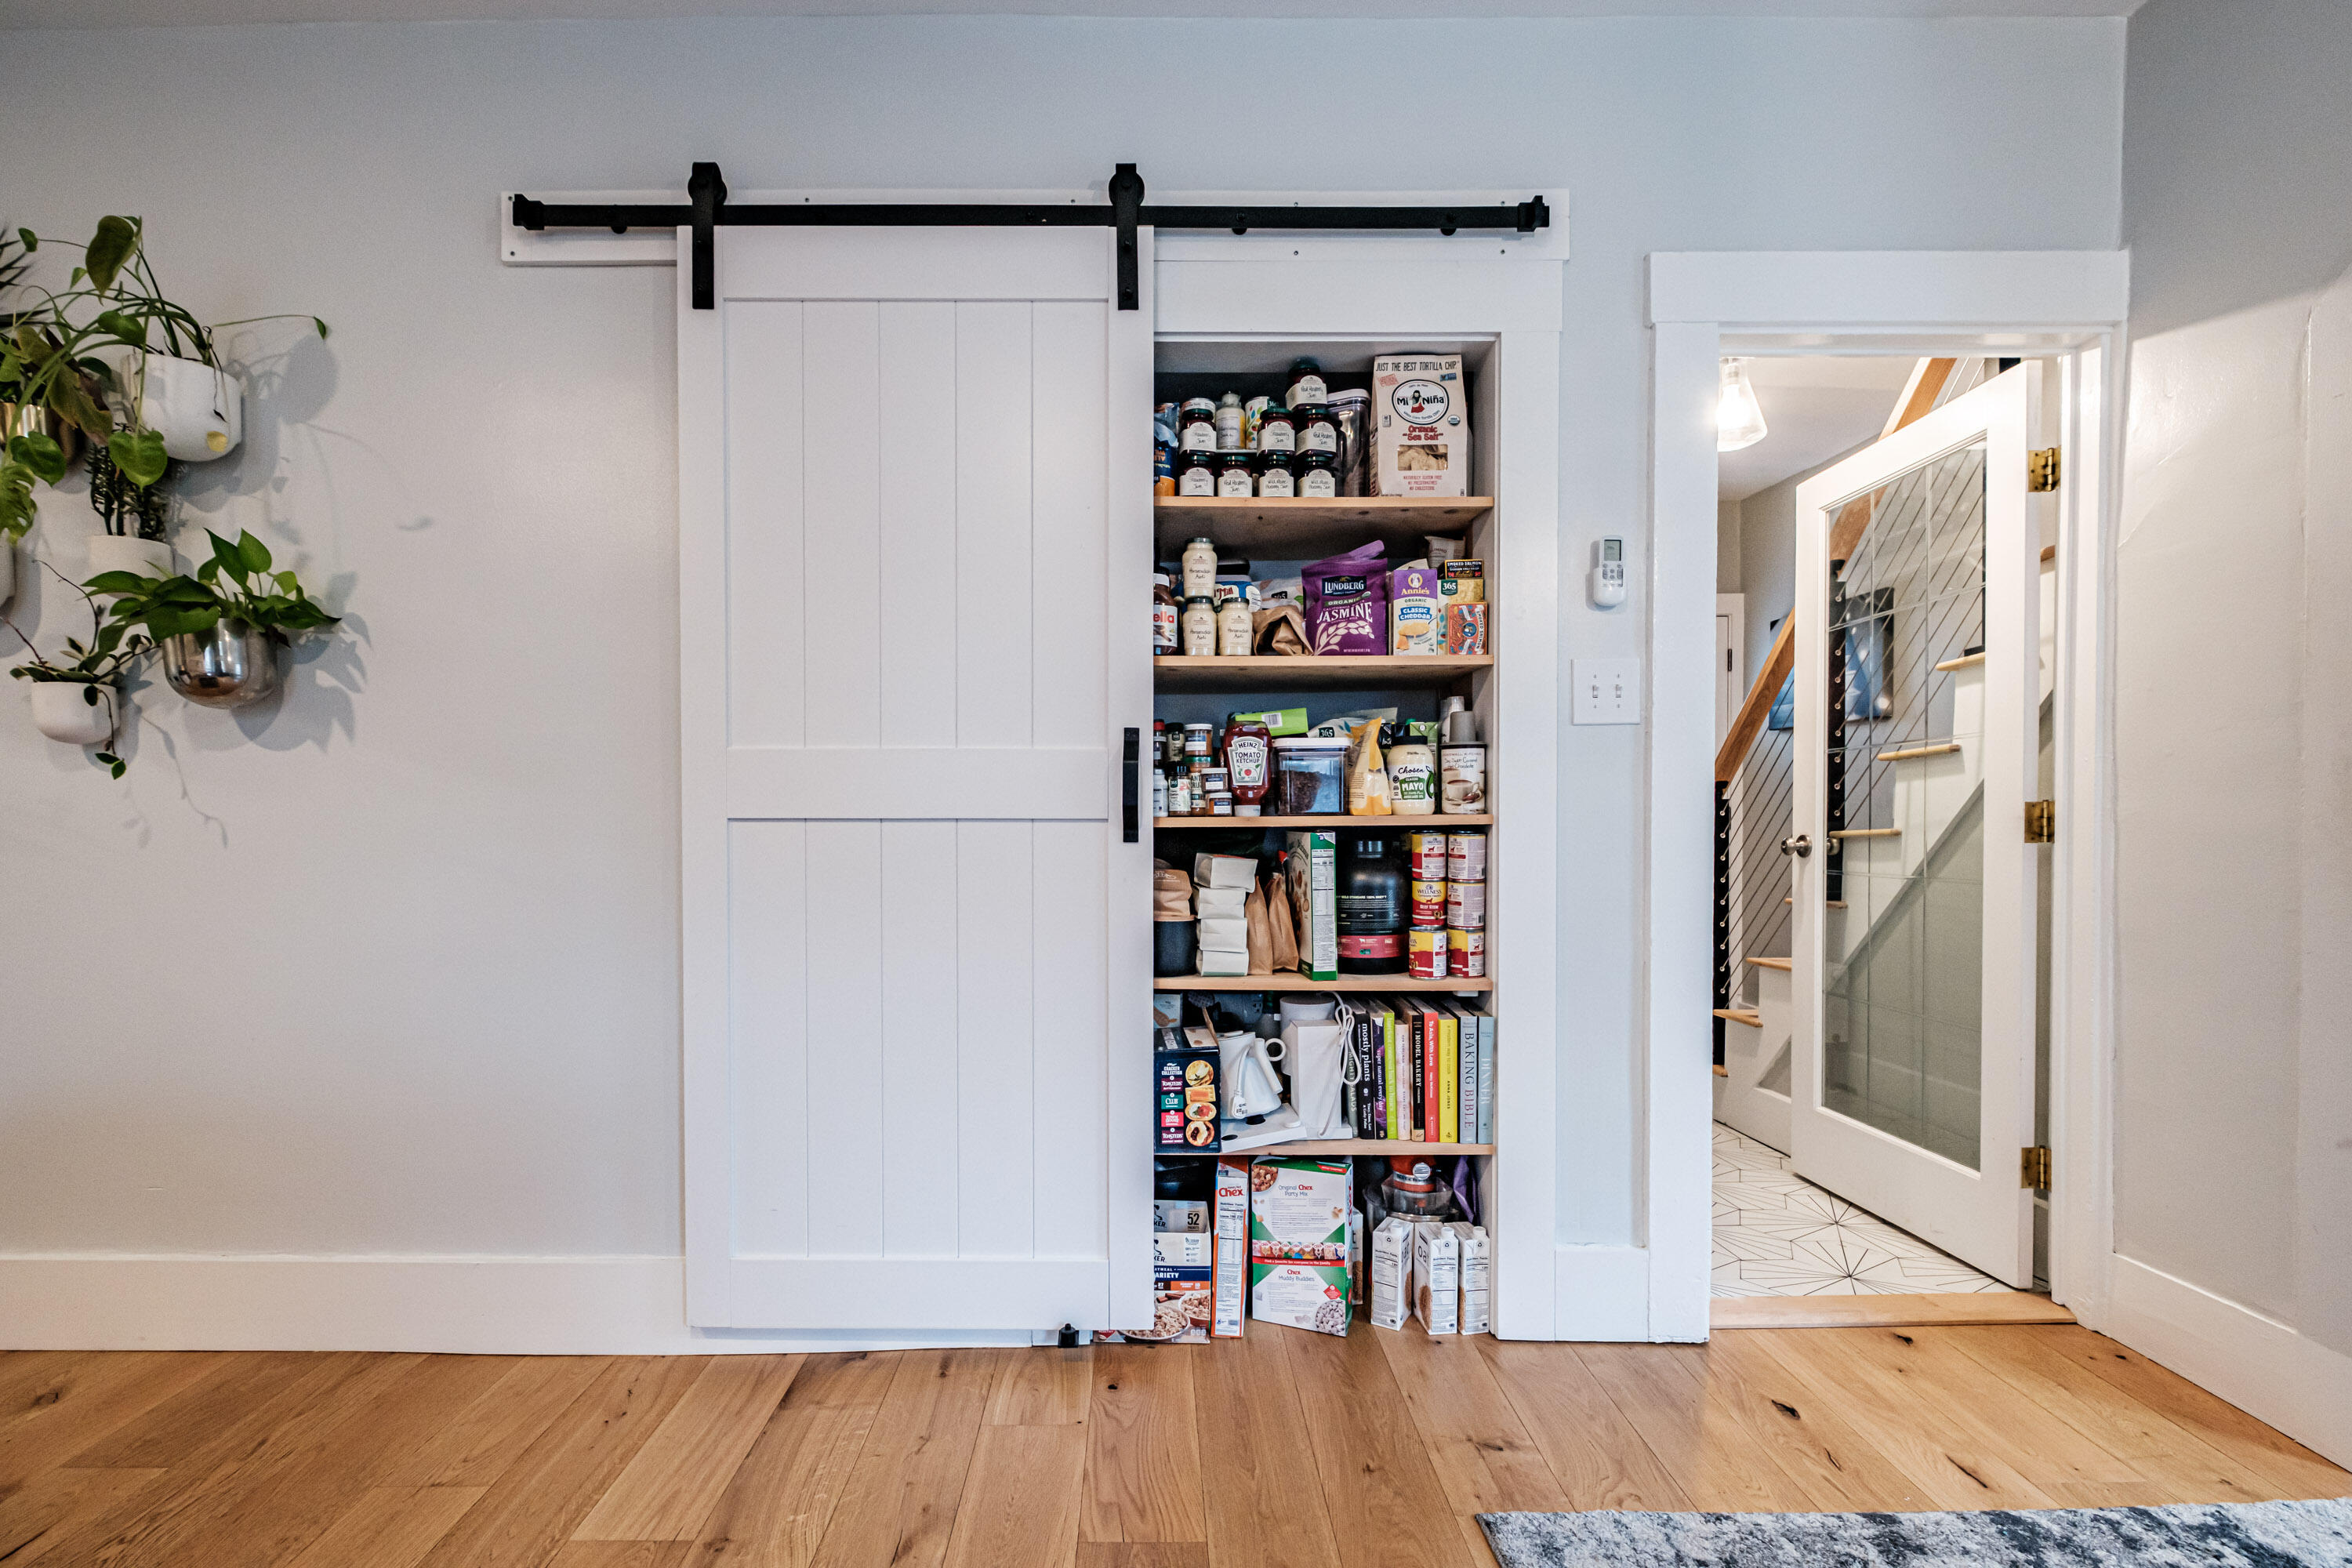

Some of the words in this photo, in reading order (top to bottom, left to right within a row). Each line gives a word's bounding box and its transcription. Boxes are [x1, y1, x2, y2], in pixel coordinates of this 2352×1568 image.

[1376, 362, 1389, 372] JUST
[1392, 362, 1401, 371] THE
[1403, 361, 1417, 371] BEST
[1420, 361, 1443, 371] TORTILLA
[1445, 361, 1457, 370] CHIP
[1422, 395, 1444, 405] Niña
[1324, 580, 1364, 593] LUNDBERG
[1401, 587, 1430, 596] Annie's
[1328, 597, 1360, 605] ORGANIC
[1316, 602, 1373, 624] JASMINE
[1402, 782, 1424, 791] MAYO
[1362, 1023, 1370, 1054] mostly
[1465, 1033, 1475, 1084] BAKING
[1362, 1054, 1371, 1082] plants
[1480, 1058, 1491, 1104] DINNER
[1465, 1090, 1475, 1129] BIBLE
[1218, 1187, 1243, 1197] Chex
[1187, 1213, 1200, 1225] 52
